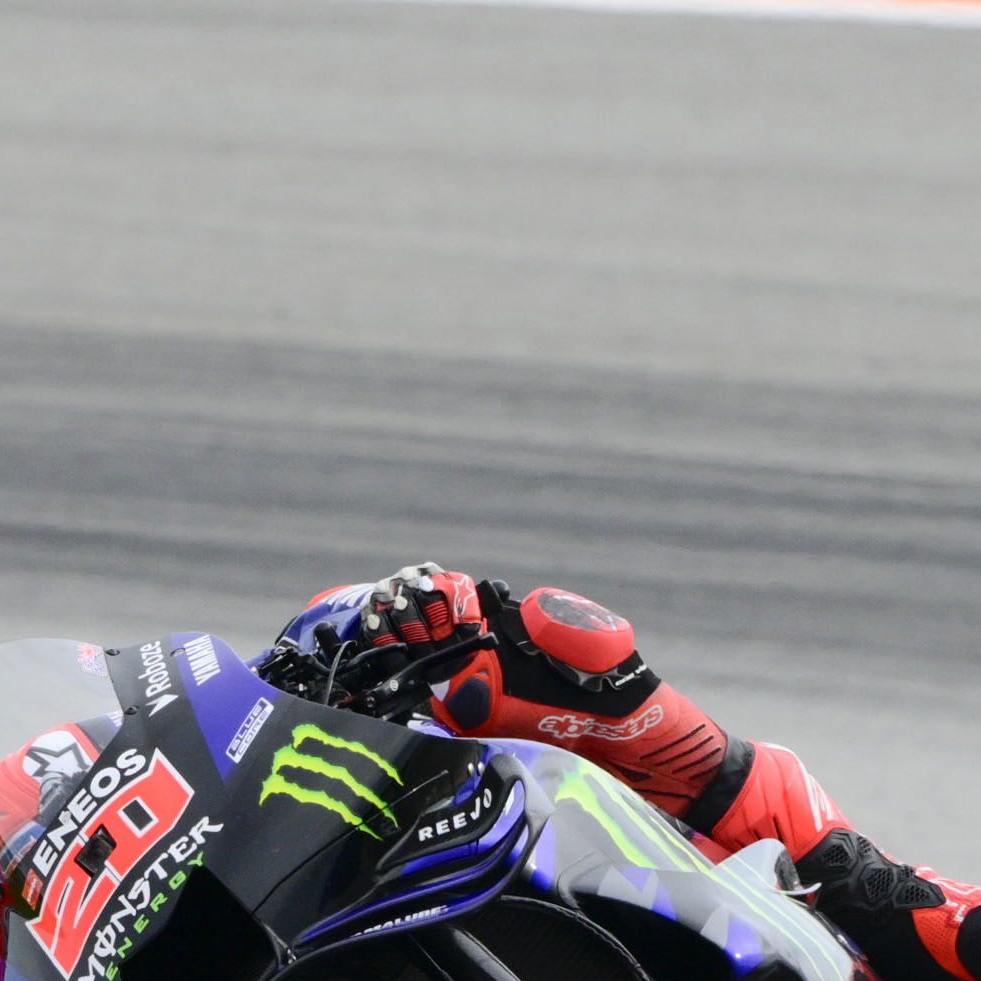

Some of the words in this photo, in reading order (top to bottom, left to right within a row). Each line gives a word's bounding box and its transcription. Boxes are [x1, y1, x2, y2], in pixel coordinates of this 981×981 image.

[138, 640, 172, 698] Roboze
[182, 634, 221, 686] YAMAHA
[32, 748, 146, 877] ENEOS
[419, 787, 493, 841] REEVO
[25, 747, 195, 981] 20
[105, 852, 204, 981] ENERGY
